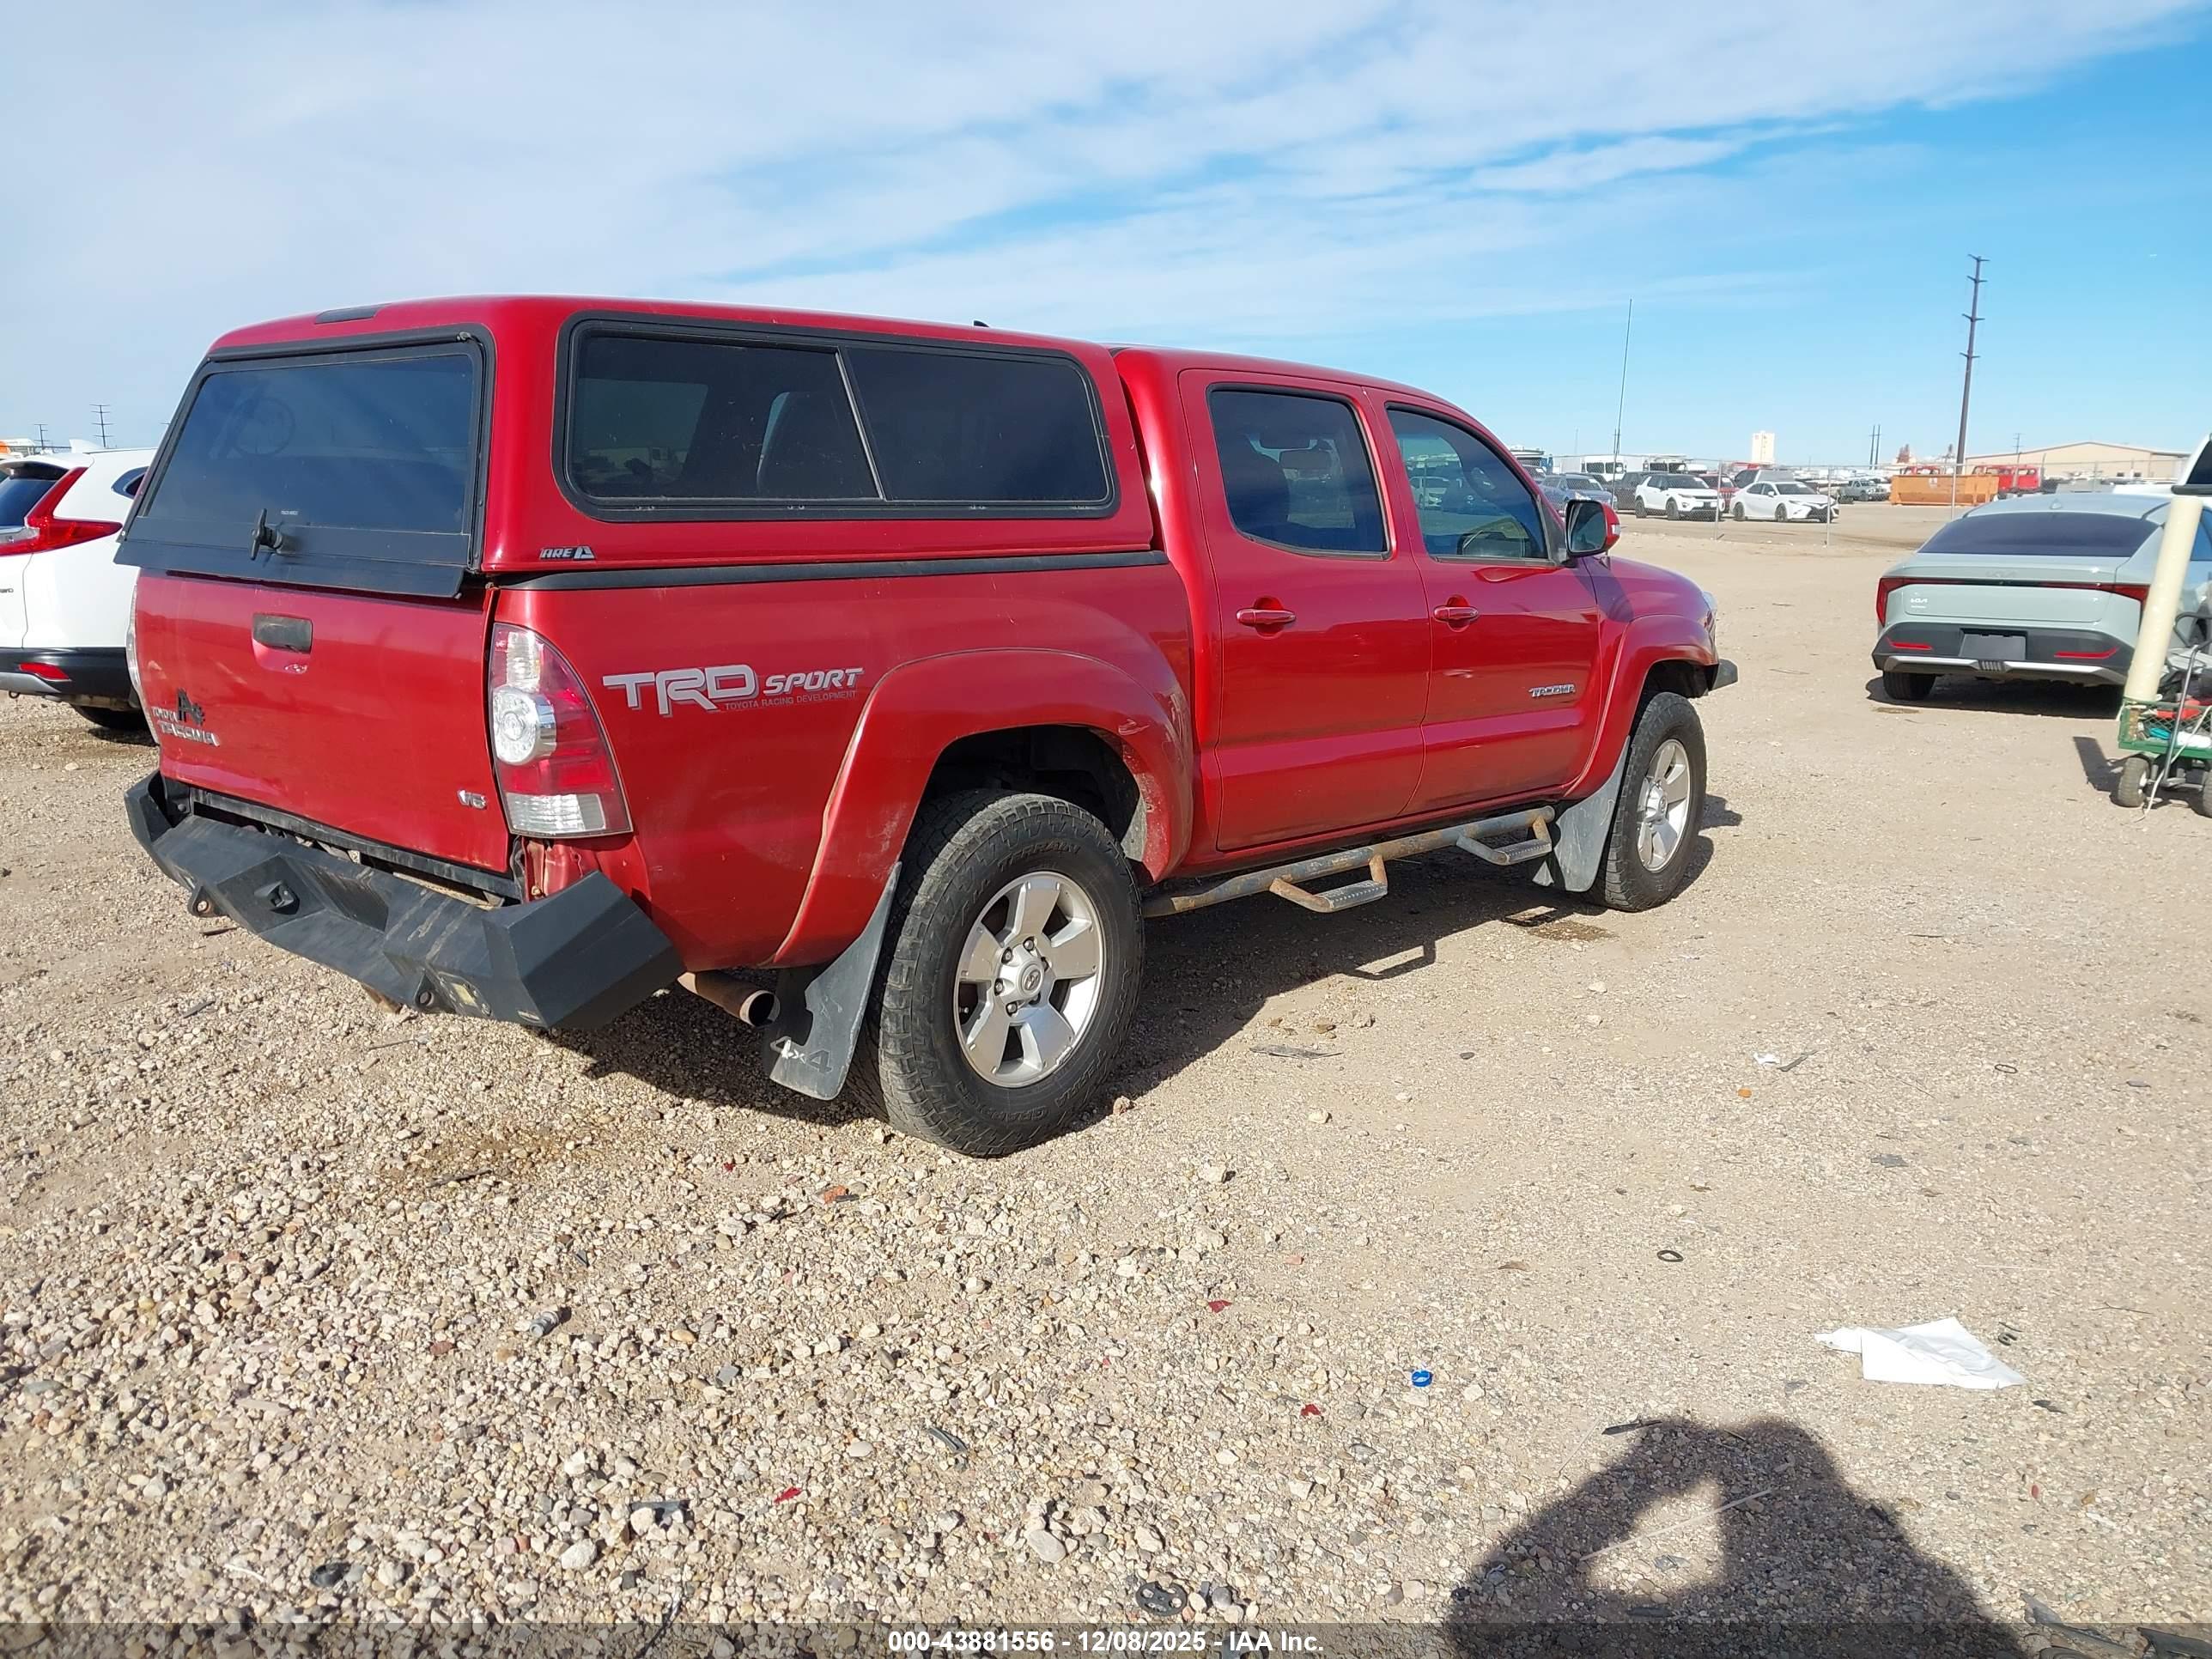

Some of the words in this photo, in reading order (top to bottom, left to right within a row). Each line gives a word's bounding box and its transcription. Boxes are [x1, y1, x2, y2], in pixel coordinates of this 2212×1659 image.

[539, 547, 573, 560] ARE
[603, 664, 757, 717] TRD
[763, 667, 865, 696] SPORT
[724, 701, 760, 711] TOYOTA
[762, 696, 794, 708] RACING
[796, 690, 857, 703] DEVELOPMENT
